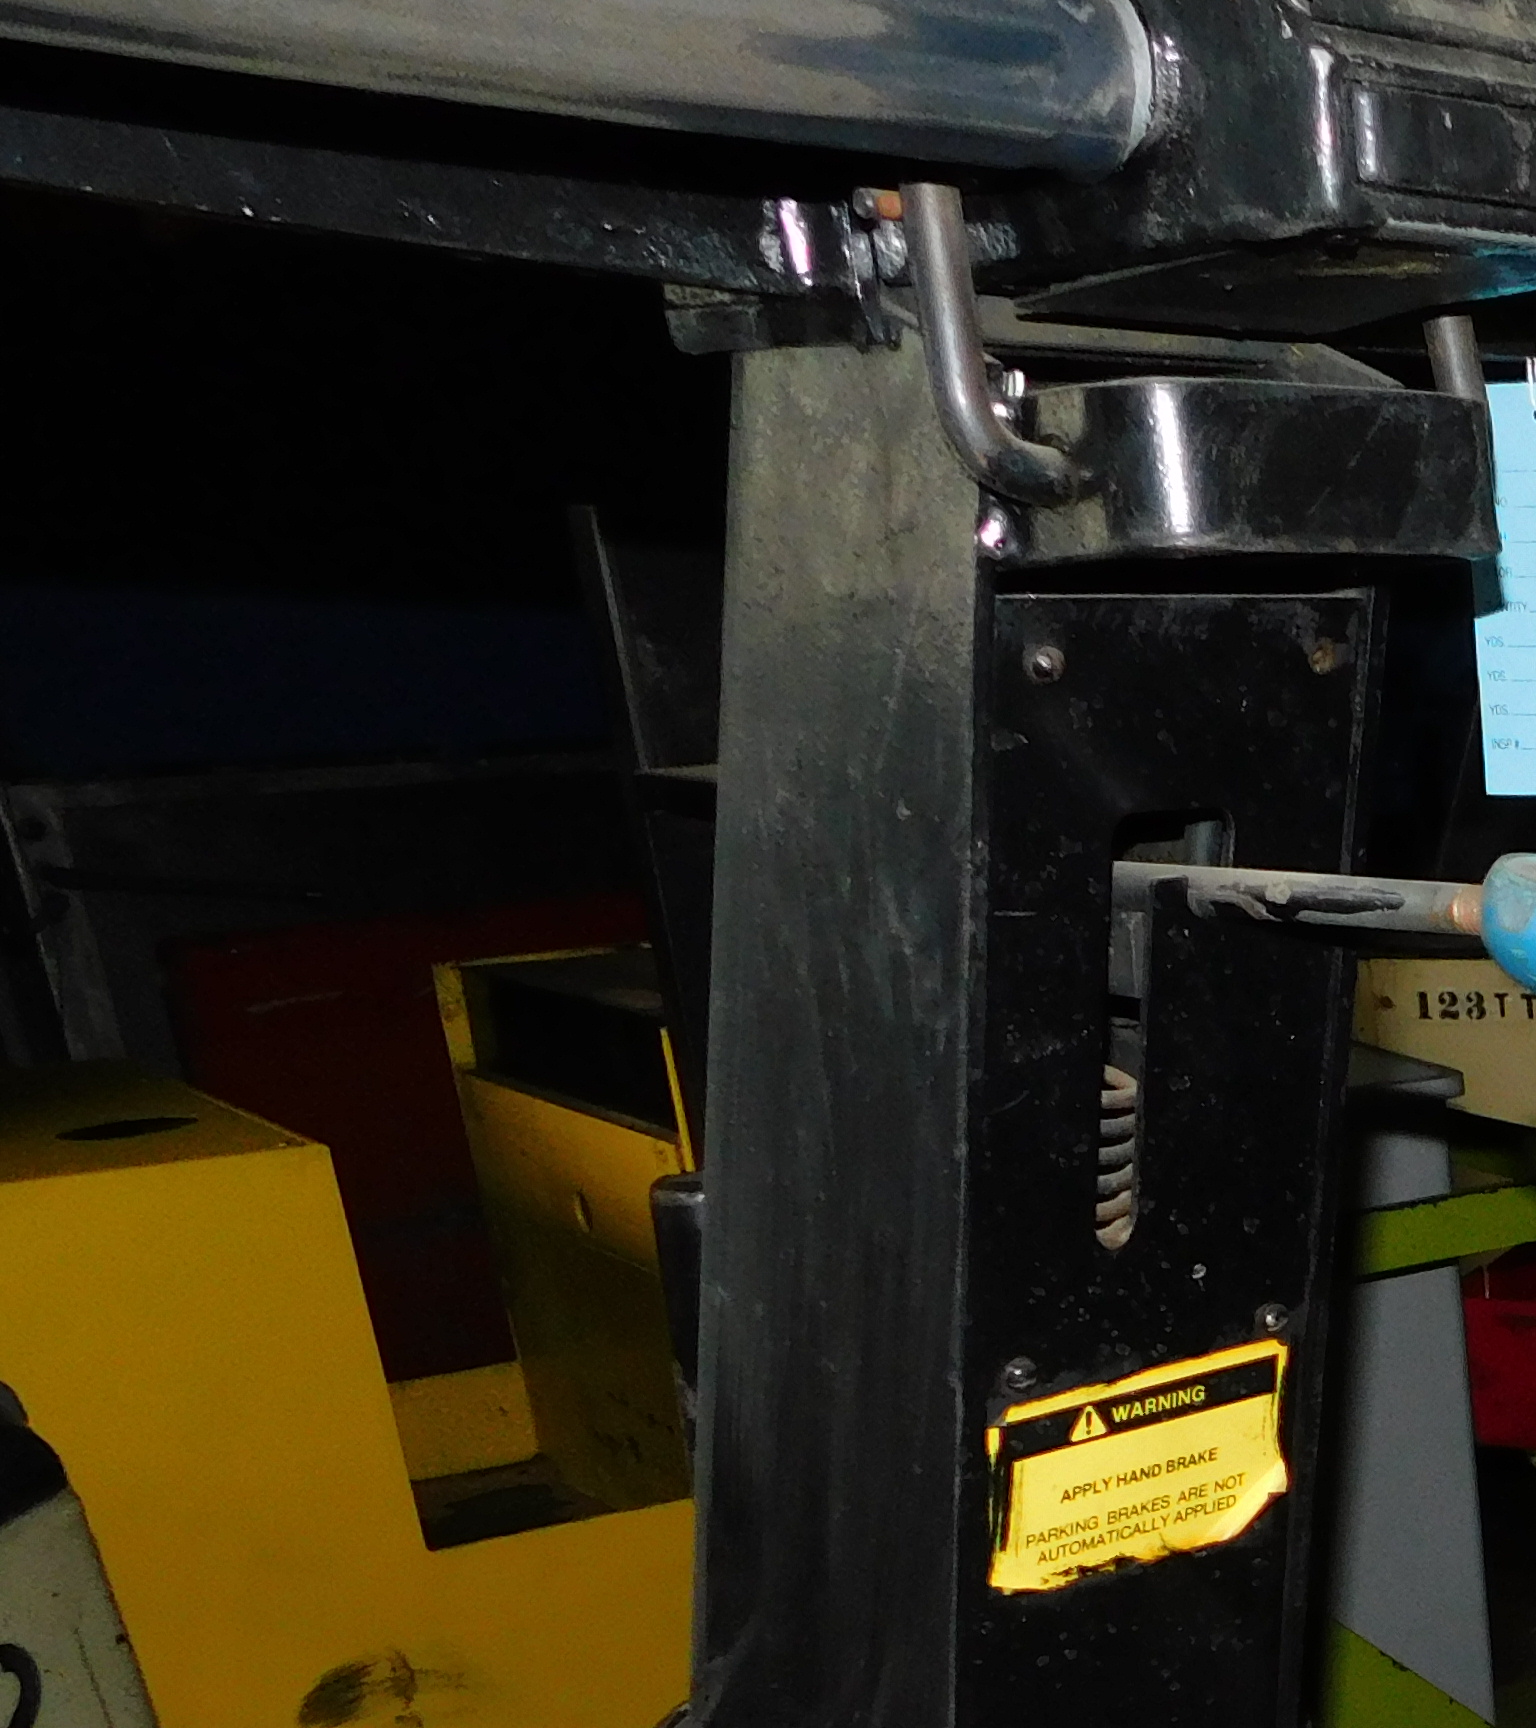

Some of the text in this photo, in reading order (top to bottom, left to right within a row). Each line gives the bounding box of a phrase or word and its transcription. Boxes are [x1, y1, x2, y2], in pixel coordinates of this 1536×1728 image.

[1112, 1386, 1206, 1423] WARNING
[1060, 1447, 1219, 1504] APPLY HAND BRAKE
[1025, 1472, 1246, 1549] PARKING BRAKES ARE NOT
[1037, 1494, 1237, 1566] AUTOMATICALLY APPLIED
